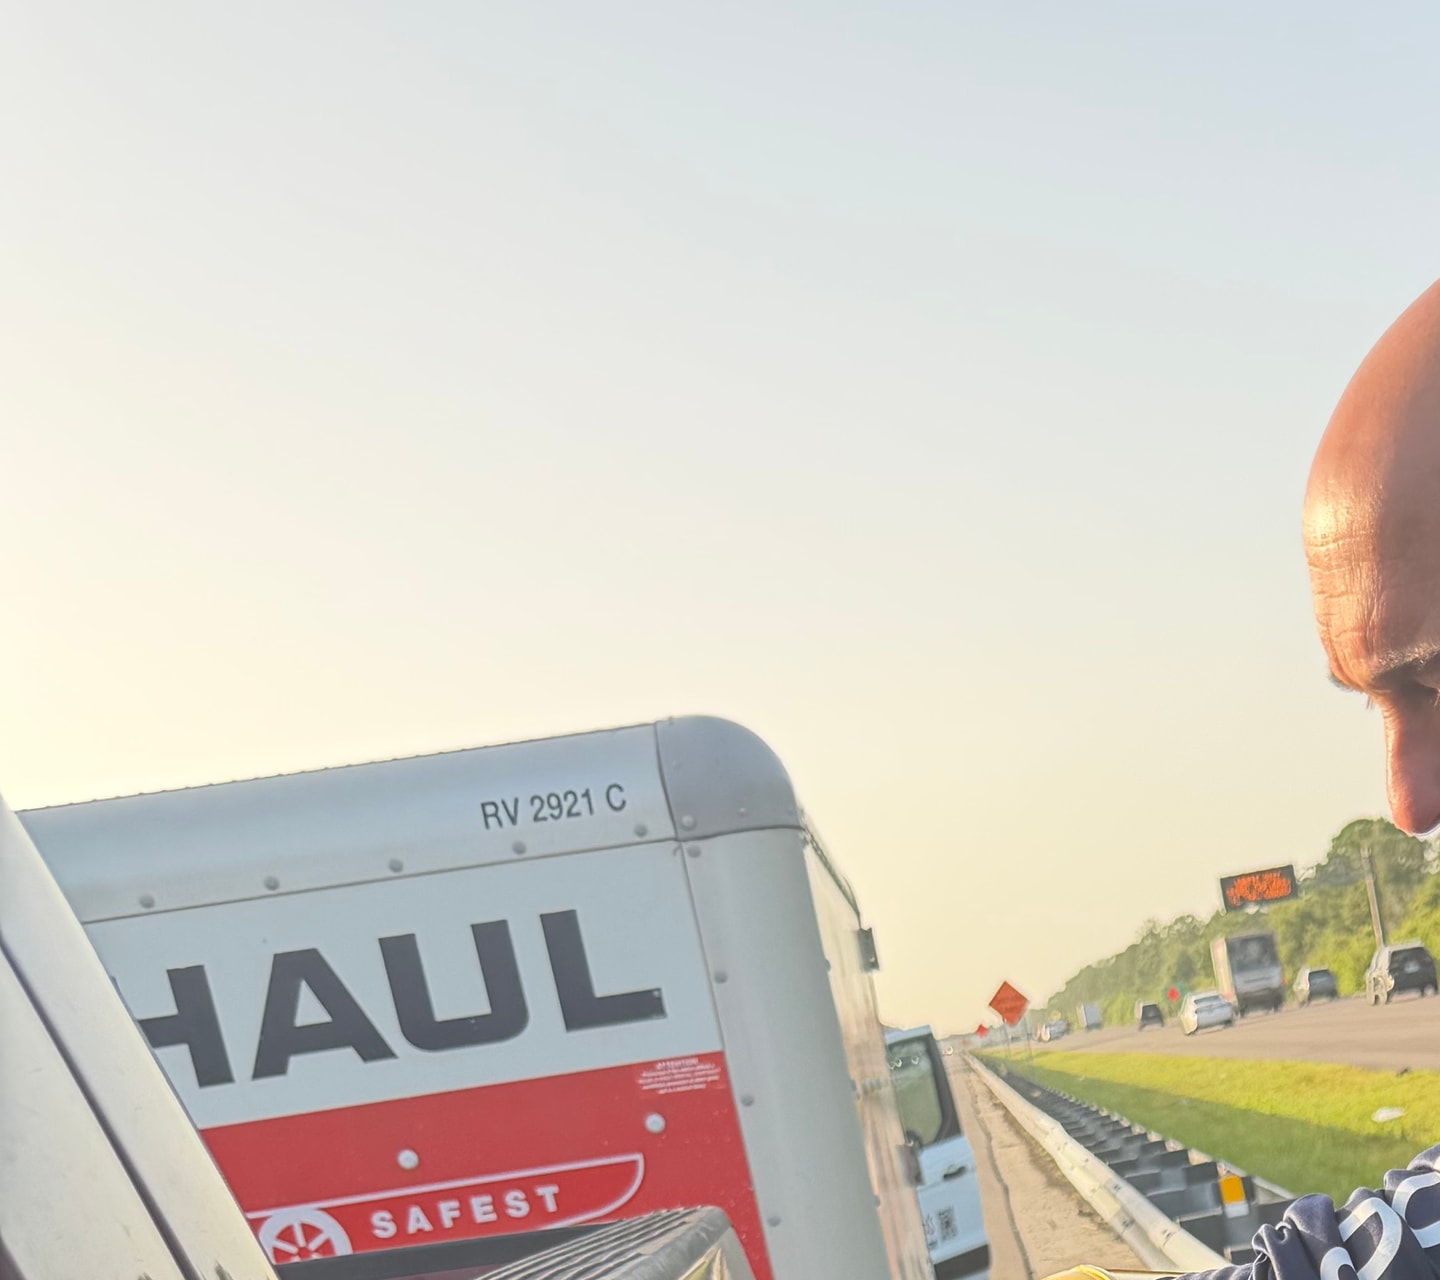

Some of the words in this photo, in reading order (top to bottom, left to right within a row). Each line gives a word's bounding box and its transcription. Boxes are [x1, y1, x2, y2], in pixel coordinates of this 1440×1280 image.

[481, 797, 519, 830] RV
[530, 788, 594, 823] 2921
[606, 783, 627, 811] C
[370, 1184, 560, 1239] SAFEST
